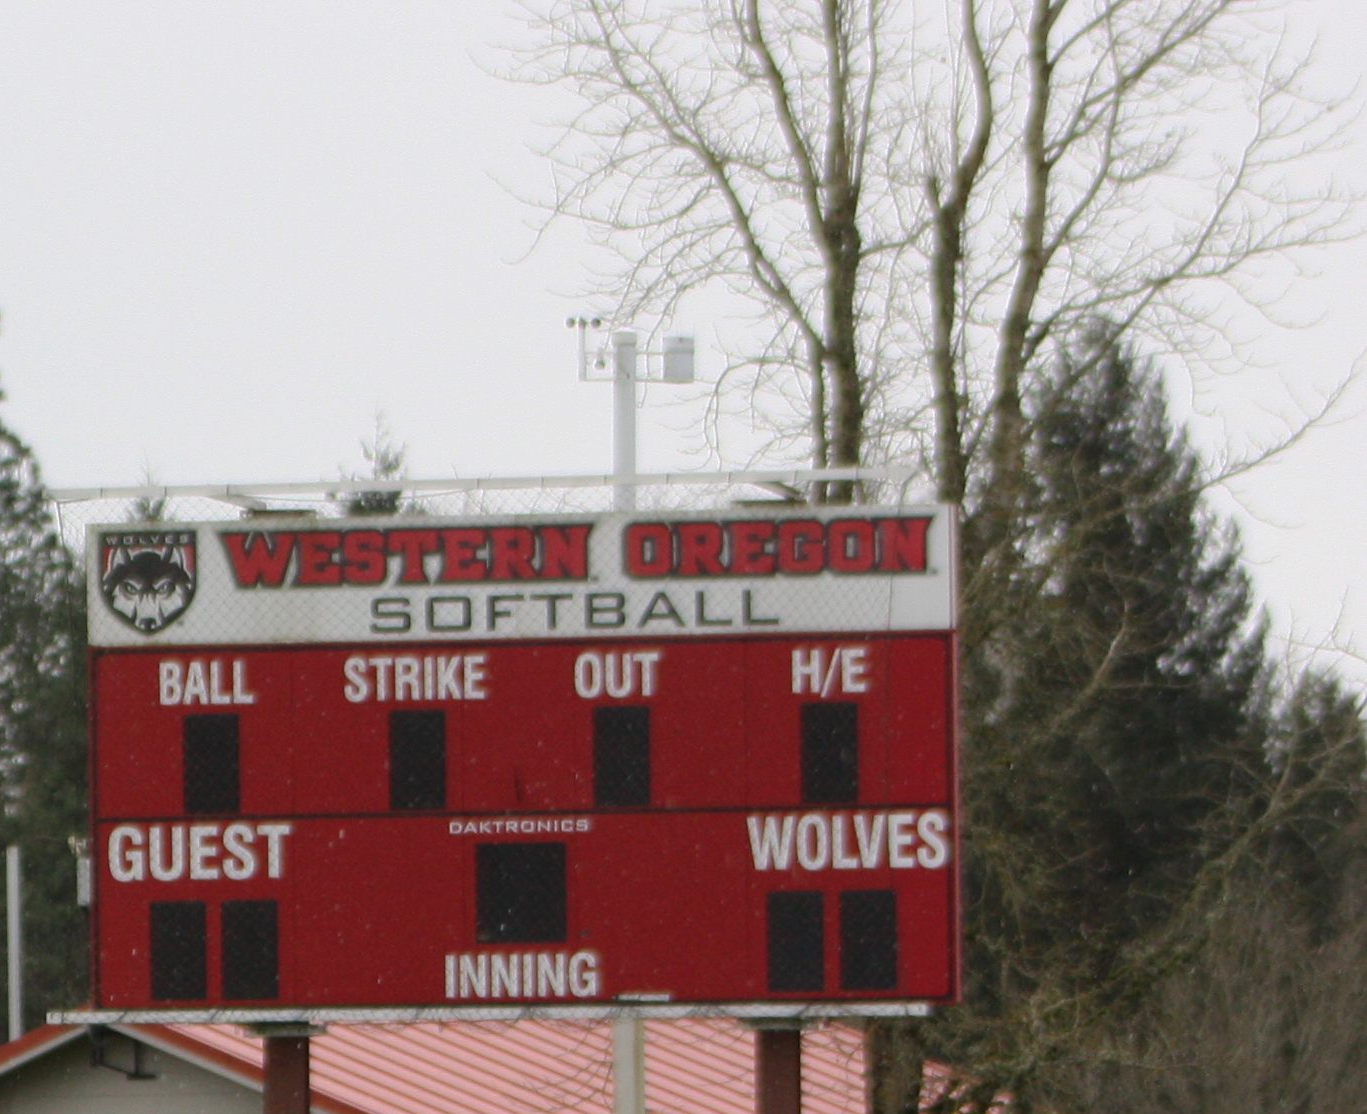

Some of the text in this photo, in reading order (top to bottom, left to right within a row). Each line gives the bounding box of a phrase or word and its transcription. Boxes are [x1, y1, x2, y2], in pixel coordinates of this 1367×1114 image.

[106, 535, 190, 546] WOLVES
[220, 516, 933, 589] WESTERN OREGON
[369, 591, 779, 634] SOFTBALL
[158, 661, 253, 705] BALL
[344, 656, 486, 702] STRIKE
[574, 652, 661, 698] OUT
[791, 648, 868, 697] H/E
[449, 819, 589, 835] DAKTRONICS
[746, 812, 948, 870] WOLVES
[108, 824, 292, 882] GUEST
[445, 952, 597, 998] INNING
